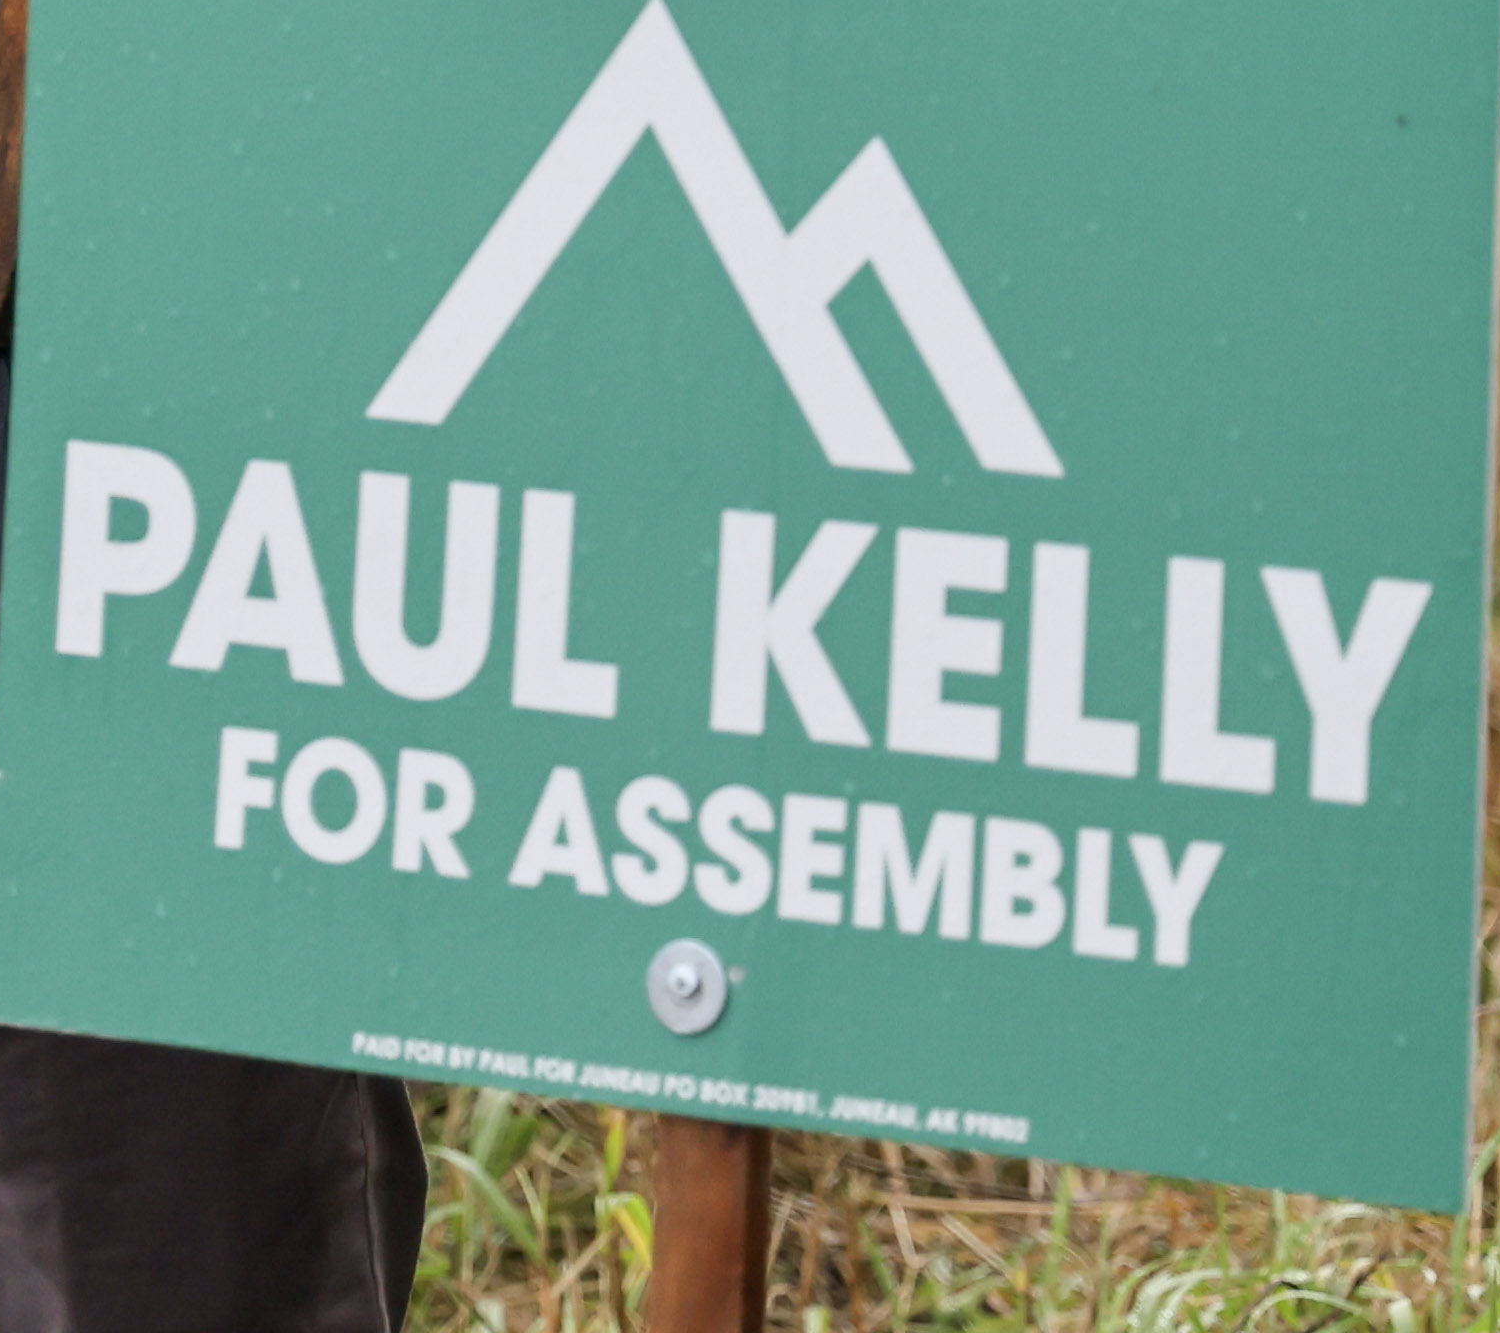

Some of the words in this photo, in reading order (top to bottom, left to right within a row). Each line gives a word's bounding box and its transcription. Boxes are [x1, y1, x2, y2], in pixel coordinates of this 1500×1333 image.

[56, 441, 617, 718] PAUL
[711, 511, 1431, 803] KELLY
[215, 728, 474, 878] FOR
[509, 768, 1222, 965] ASSEMBLY
